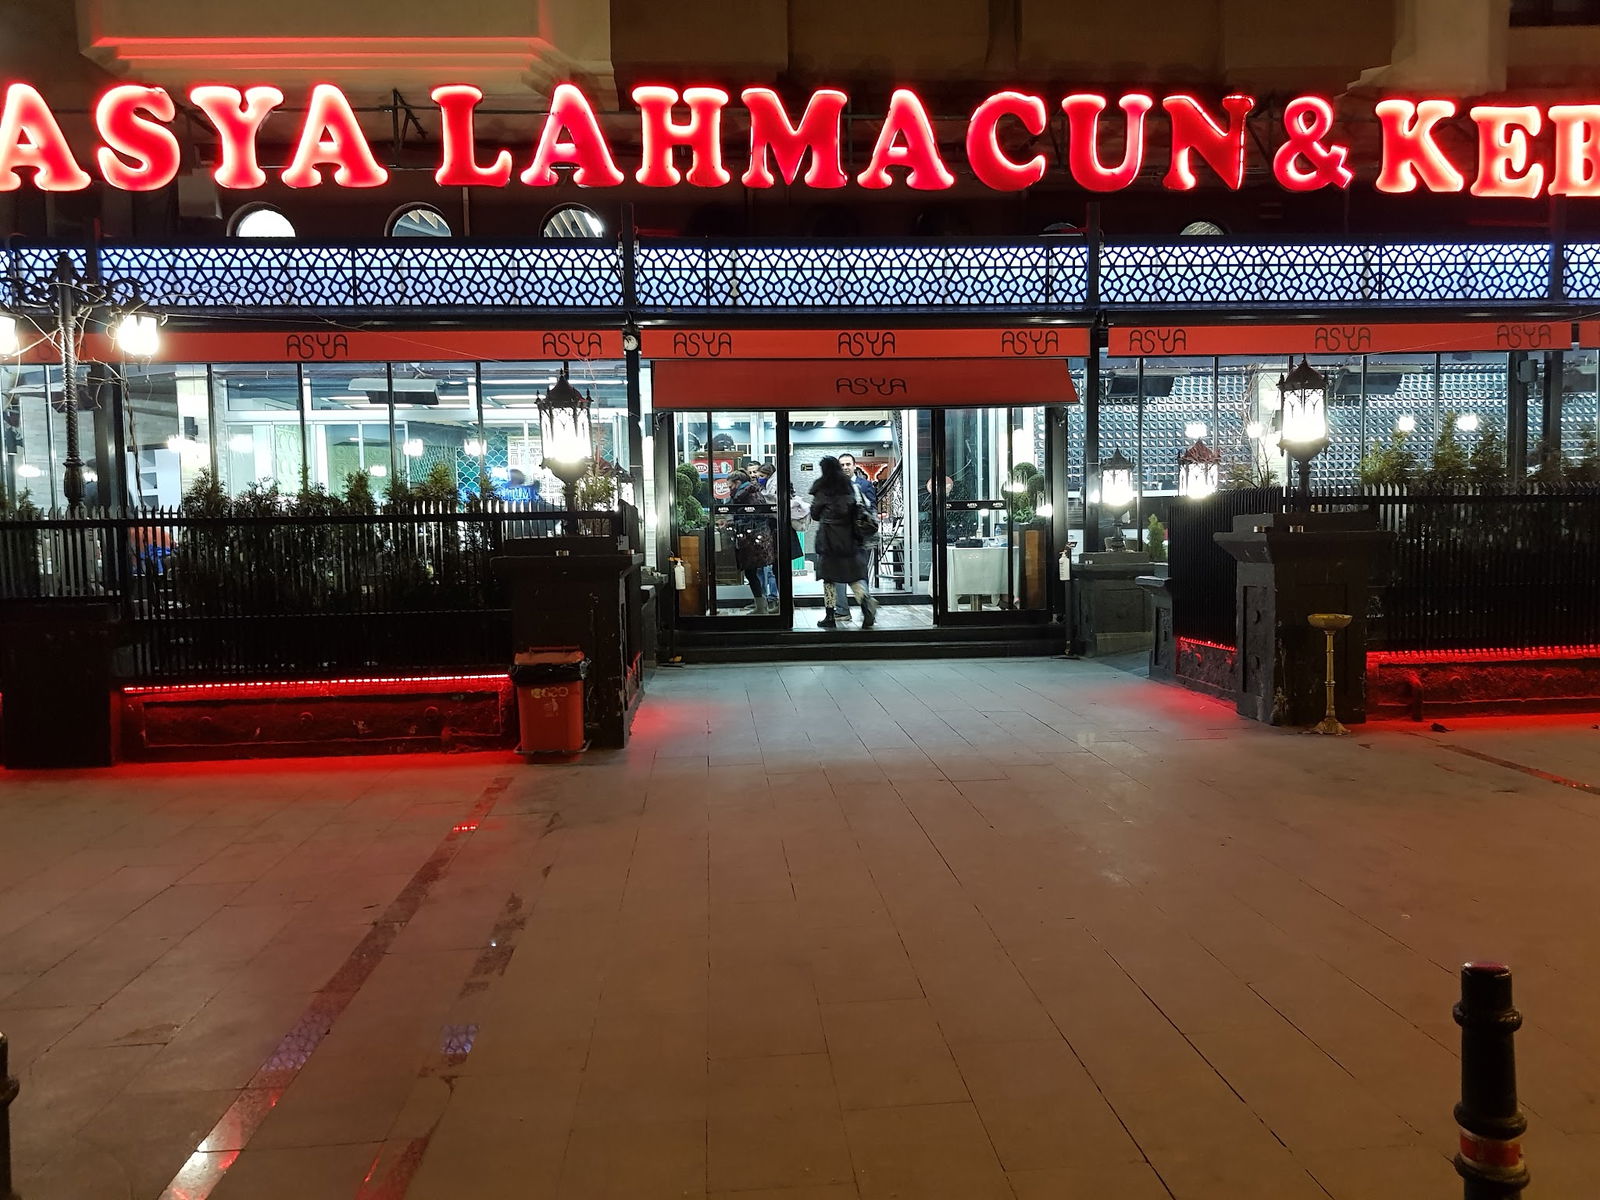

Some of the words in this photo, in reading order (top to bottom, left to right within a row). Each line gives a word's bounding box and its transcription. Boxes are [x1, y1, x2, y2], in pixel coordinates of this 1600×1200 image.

[0, 82, 390, 192] ASYA
[430, 82, 1254, 193] LAHMACUN
[1273, 96, 1355, 192] &
[1374, 99, 1600, 199] KEB
[286, 333, 348, 360] ASYA
[542, 331, 603, 358] ASYA
[673, 331, 732, 357] ASYA
[837, 331, 896, 357] ASYA
[1001, 329, 1059, 355] ASYA
[1128, 328, 1187, 354] ASYA
[1314, 326, 1371, 352] ASYA
[1496, 323, 1552, 349] ASYA
[836, 376, 907, 396] ASYA
